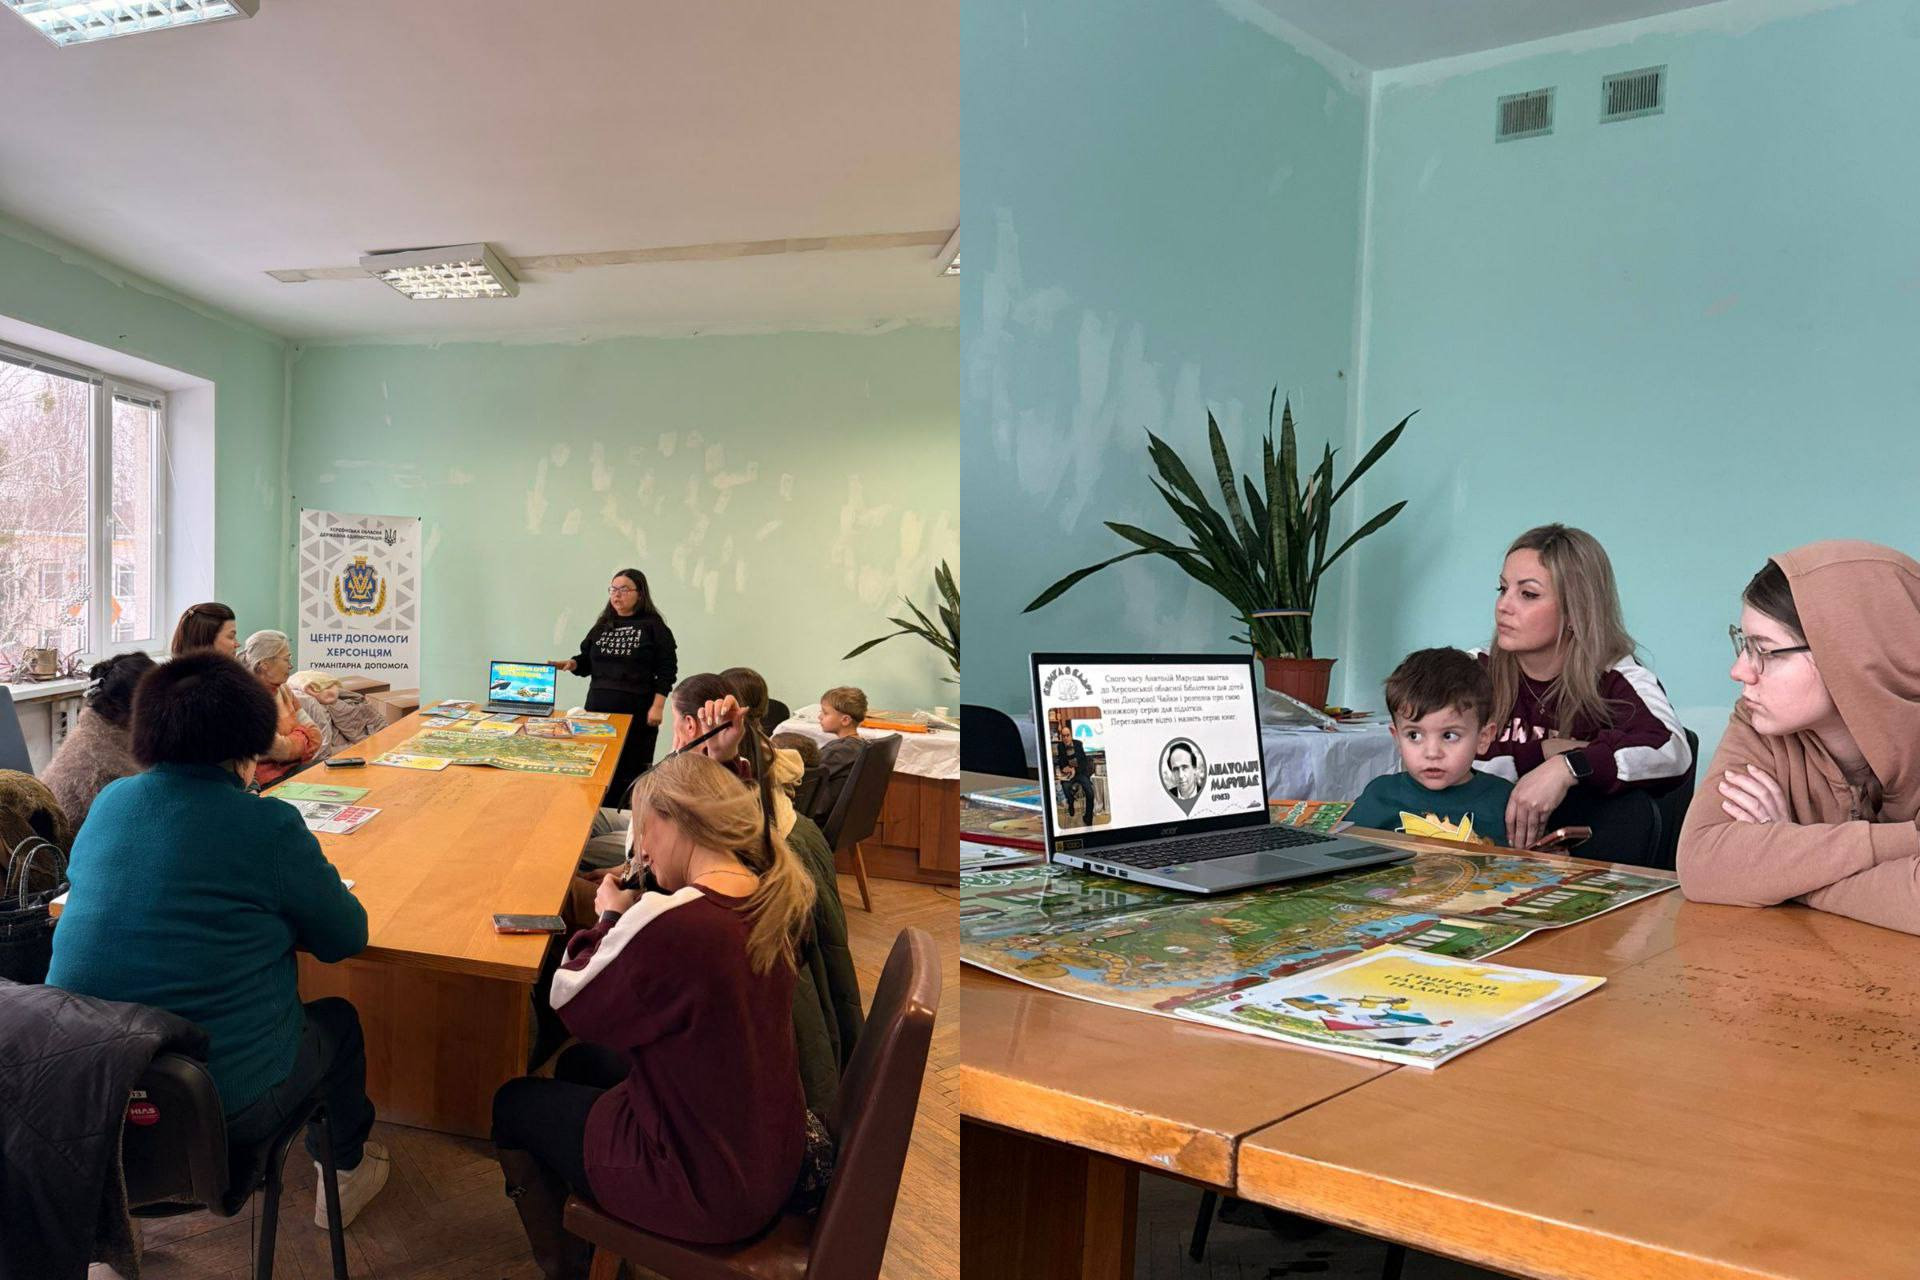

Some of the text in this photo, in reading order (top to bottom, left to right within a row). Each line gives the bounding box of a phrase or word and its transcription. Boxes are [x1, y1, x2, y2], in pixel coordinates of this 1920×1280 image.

[310, 633, 409, 644] ЦЕНТР ДОПОМОГИ
[327, 647, 392, 658] ХЕРСОНЦЯМ
[310, 661, 409, 670] ГУМАНІТАРНА ДОПОМОГА
[1127, 675, 1143, 684] часу
